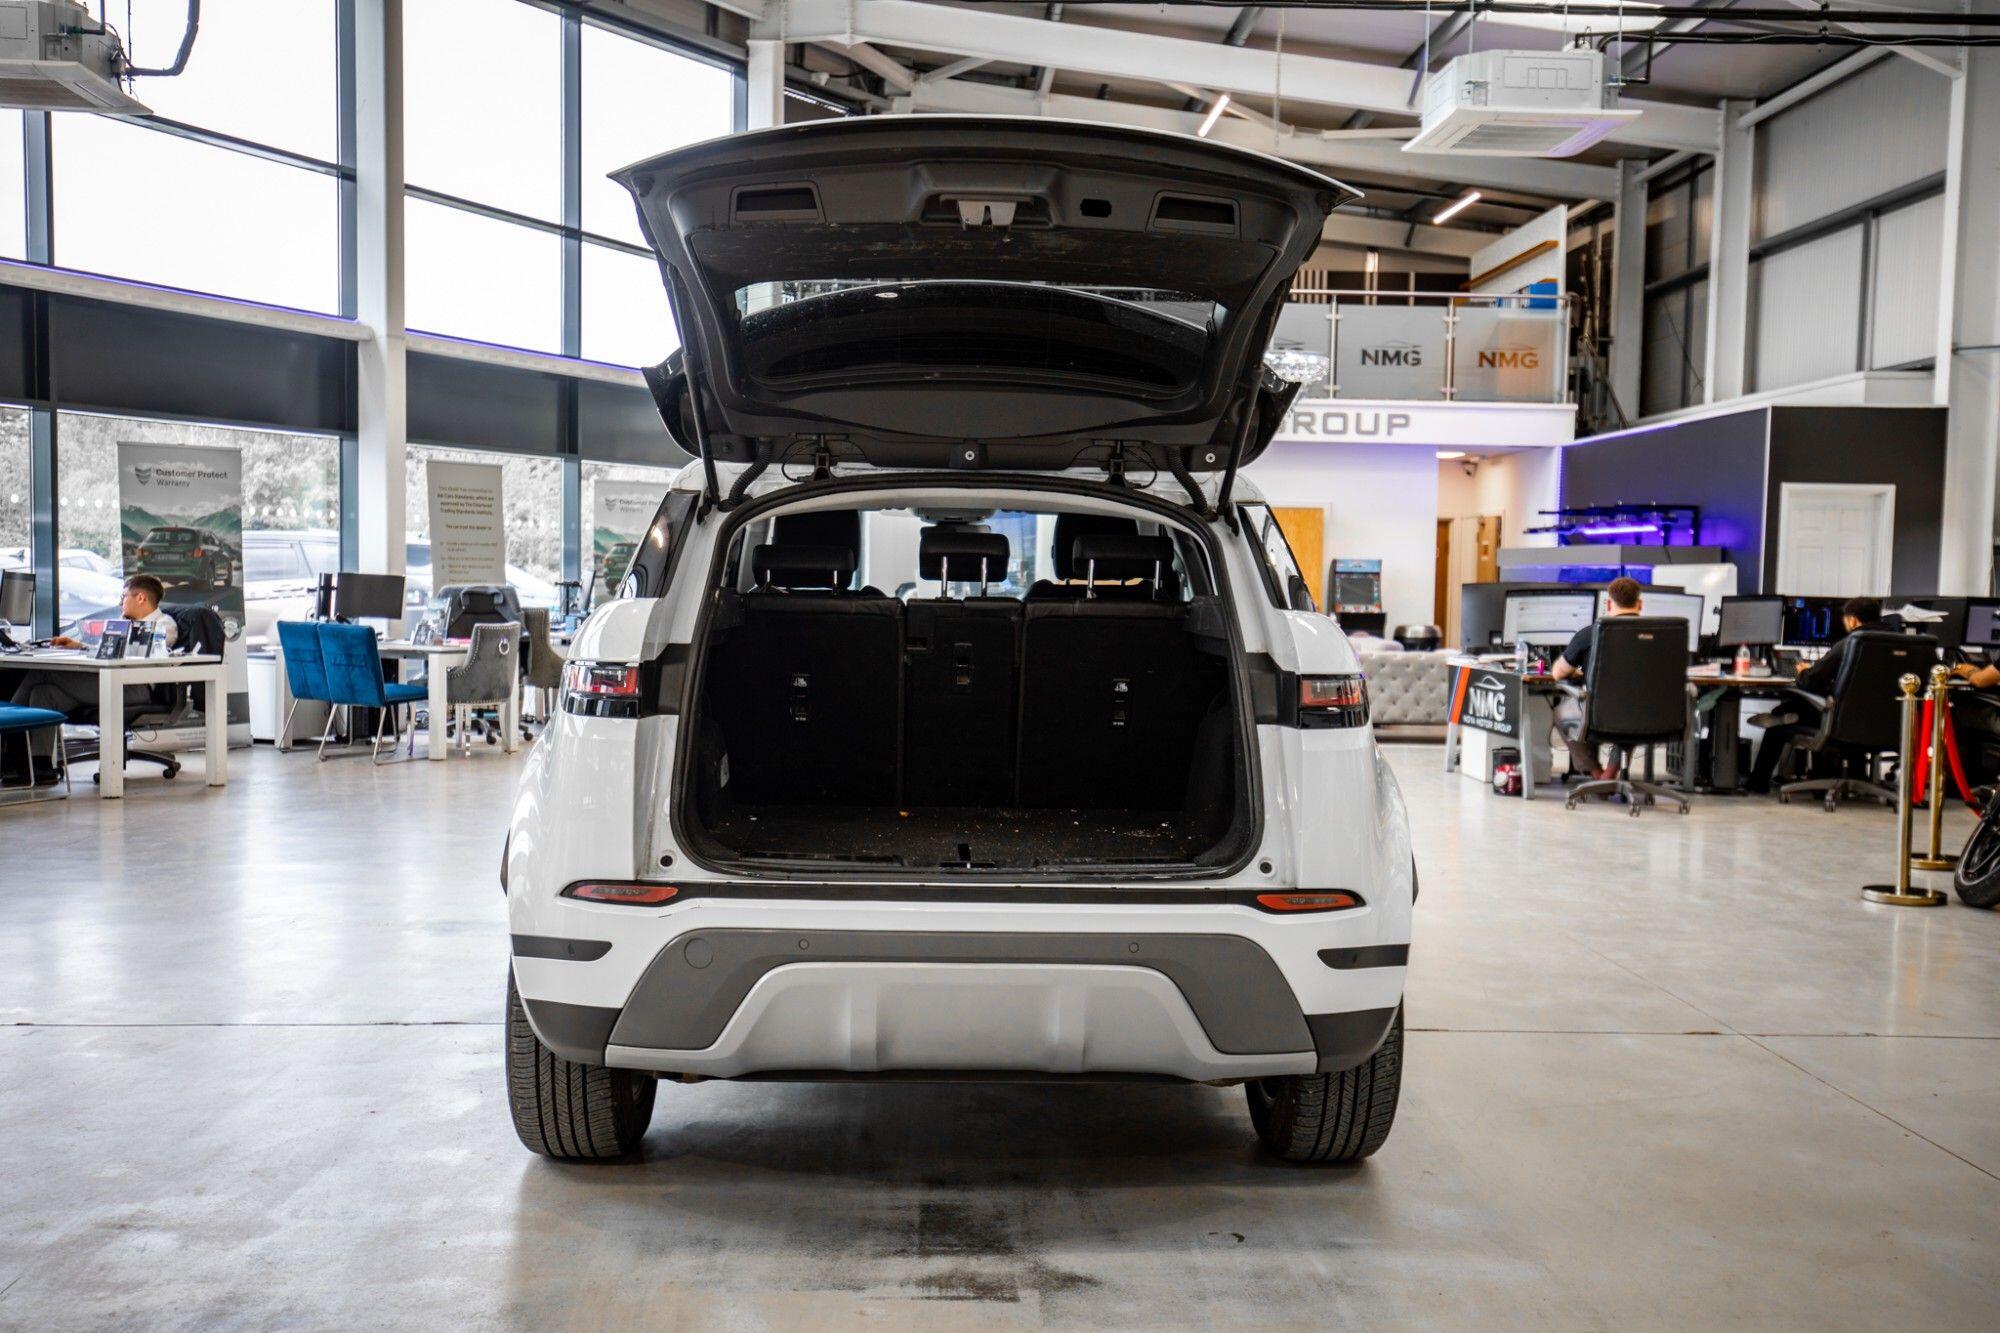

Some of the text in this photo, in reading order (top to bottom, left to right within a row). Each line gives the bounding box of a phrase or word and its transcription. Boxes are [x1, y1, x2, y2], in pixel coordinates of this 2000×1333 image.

[1361, 348, 1422, 366] NMG
[1478, 351, 1539, 369] NMG
[156, 468, 228, 479] Customer Protect
[156, 479, 191, 488] Warranty
[1469, 687, 1506, 722] NMG
[1493, 721, 1512, 734] GROUP
